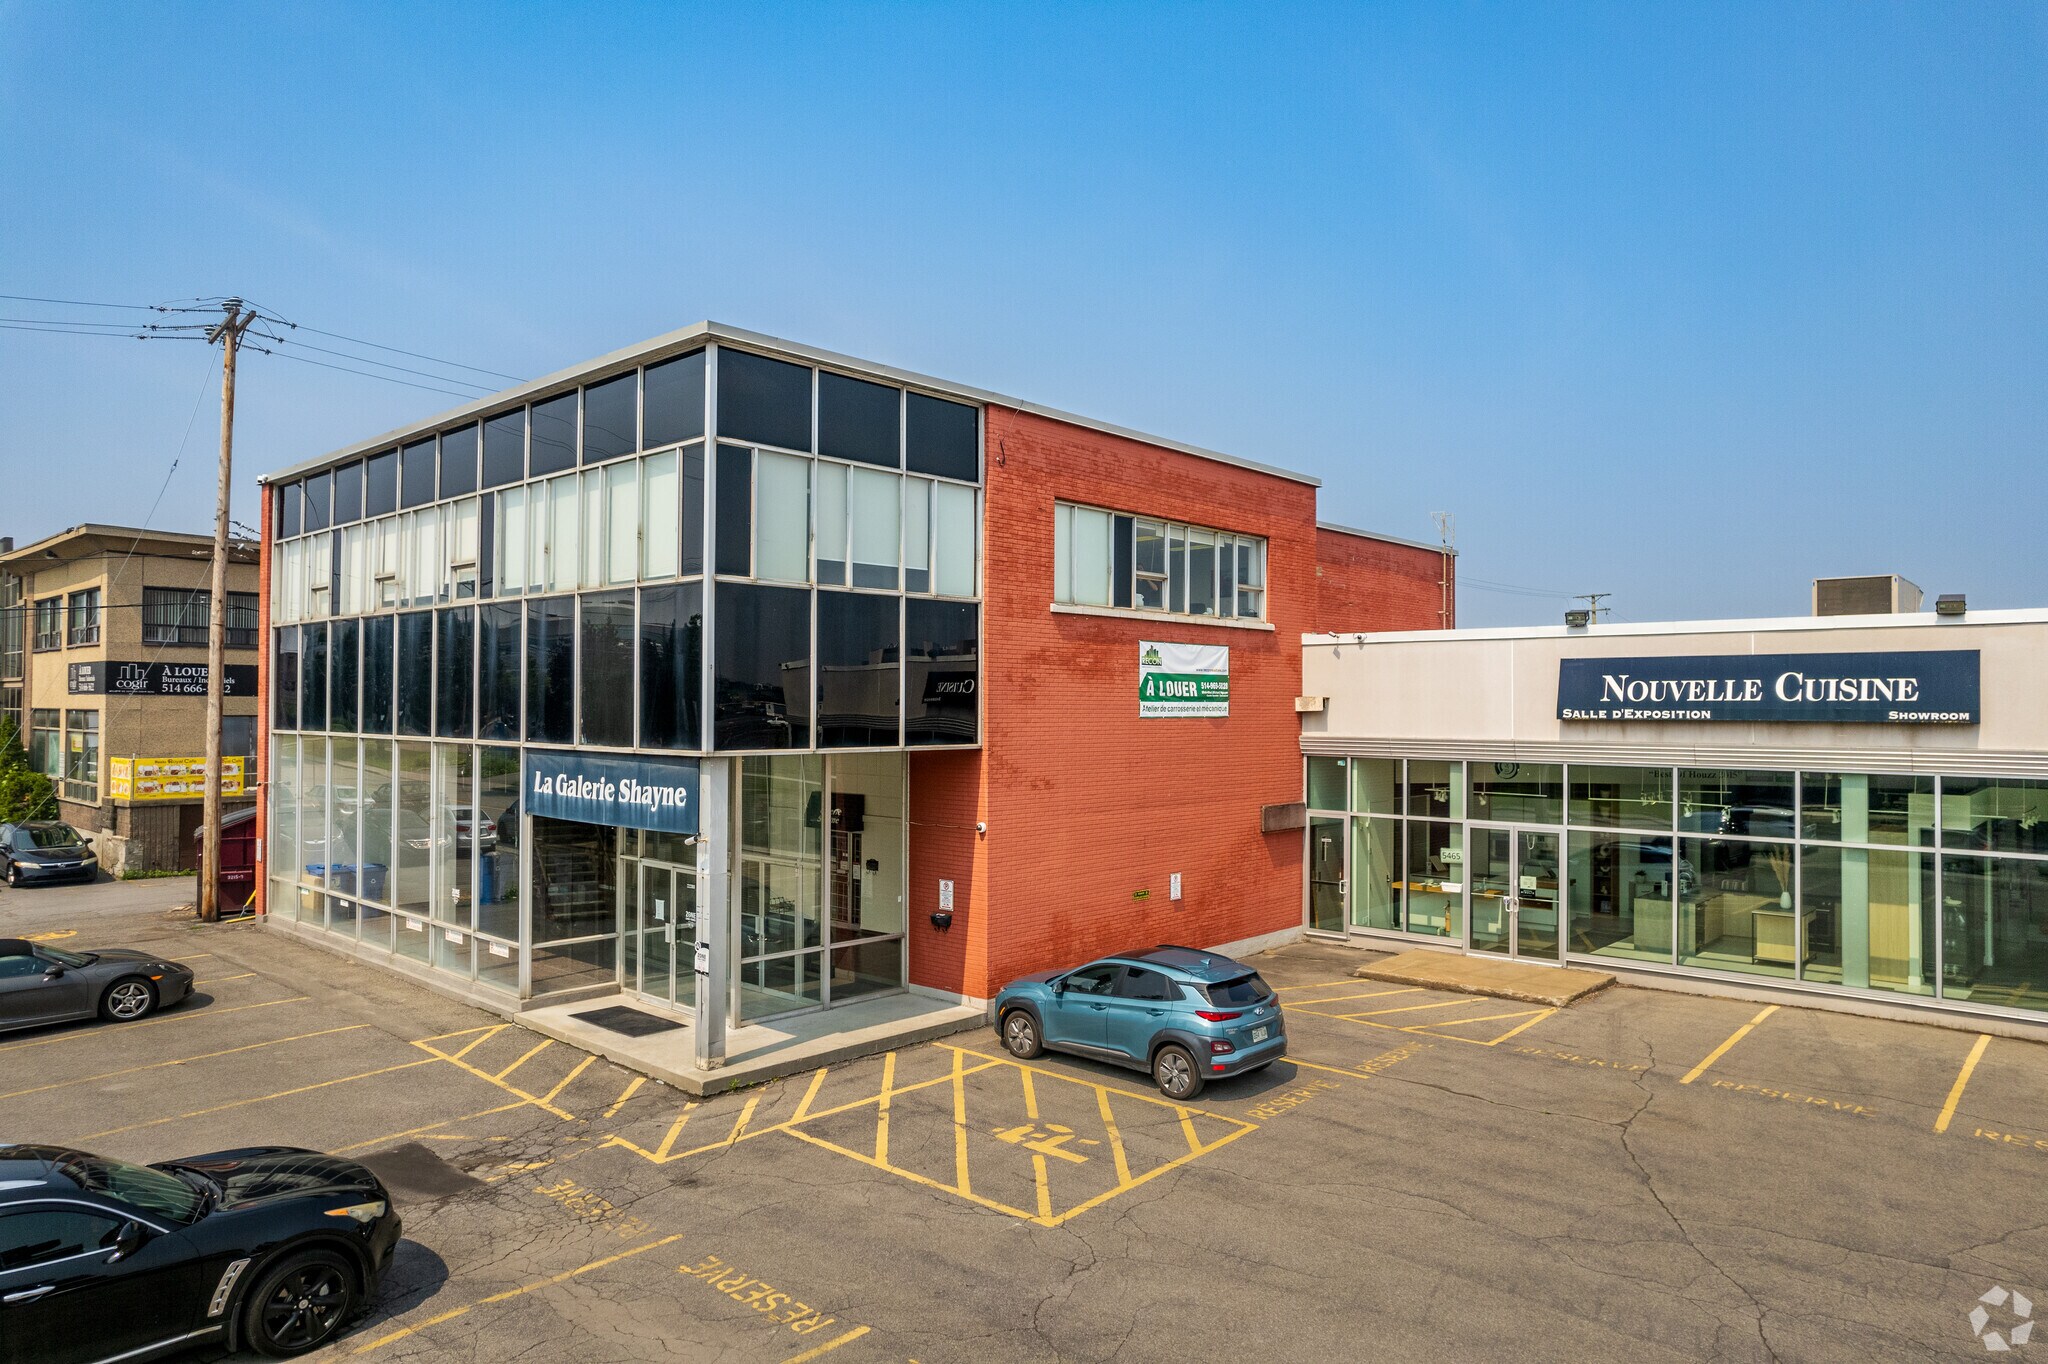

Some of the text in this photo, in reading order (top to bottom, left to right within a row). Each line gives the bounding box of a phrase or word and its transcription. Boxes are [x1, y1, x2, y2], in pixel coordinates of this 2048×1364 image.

[162, 665, 209, 676] À LOUE
[116, 679, 148, 690] cogir
[162, 675, 192, 684] Bureaux
[162, 683, 180, 693] 514
[183, 683, 231, 694] 666-2
[1146, 676, 1198, 697] À LOUER
[1600, 672, 1920, 702] NOUVELLE CUISINE
[1562, 708, 1607, 719] SALLE
[1888, 710, 1970, 721] SHOWROOM
[533, 770, 687, 812] La Galerie Shayne
[1442, 851, 1461, 860] 5465
